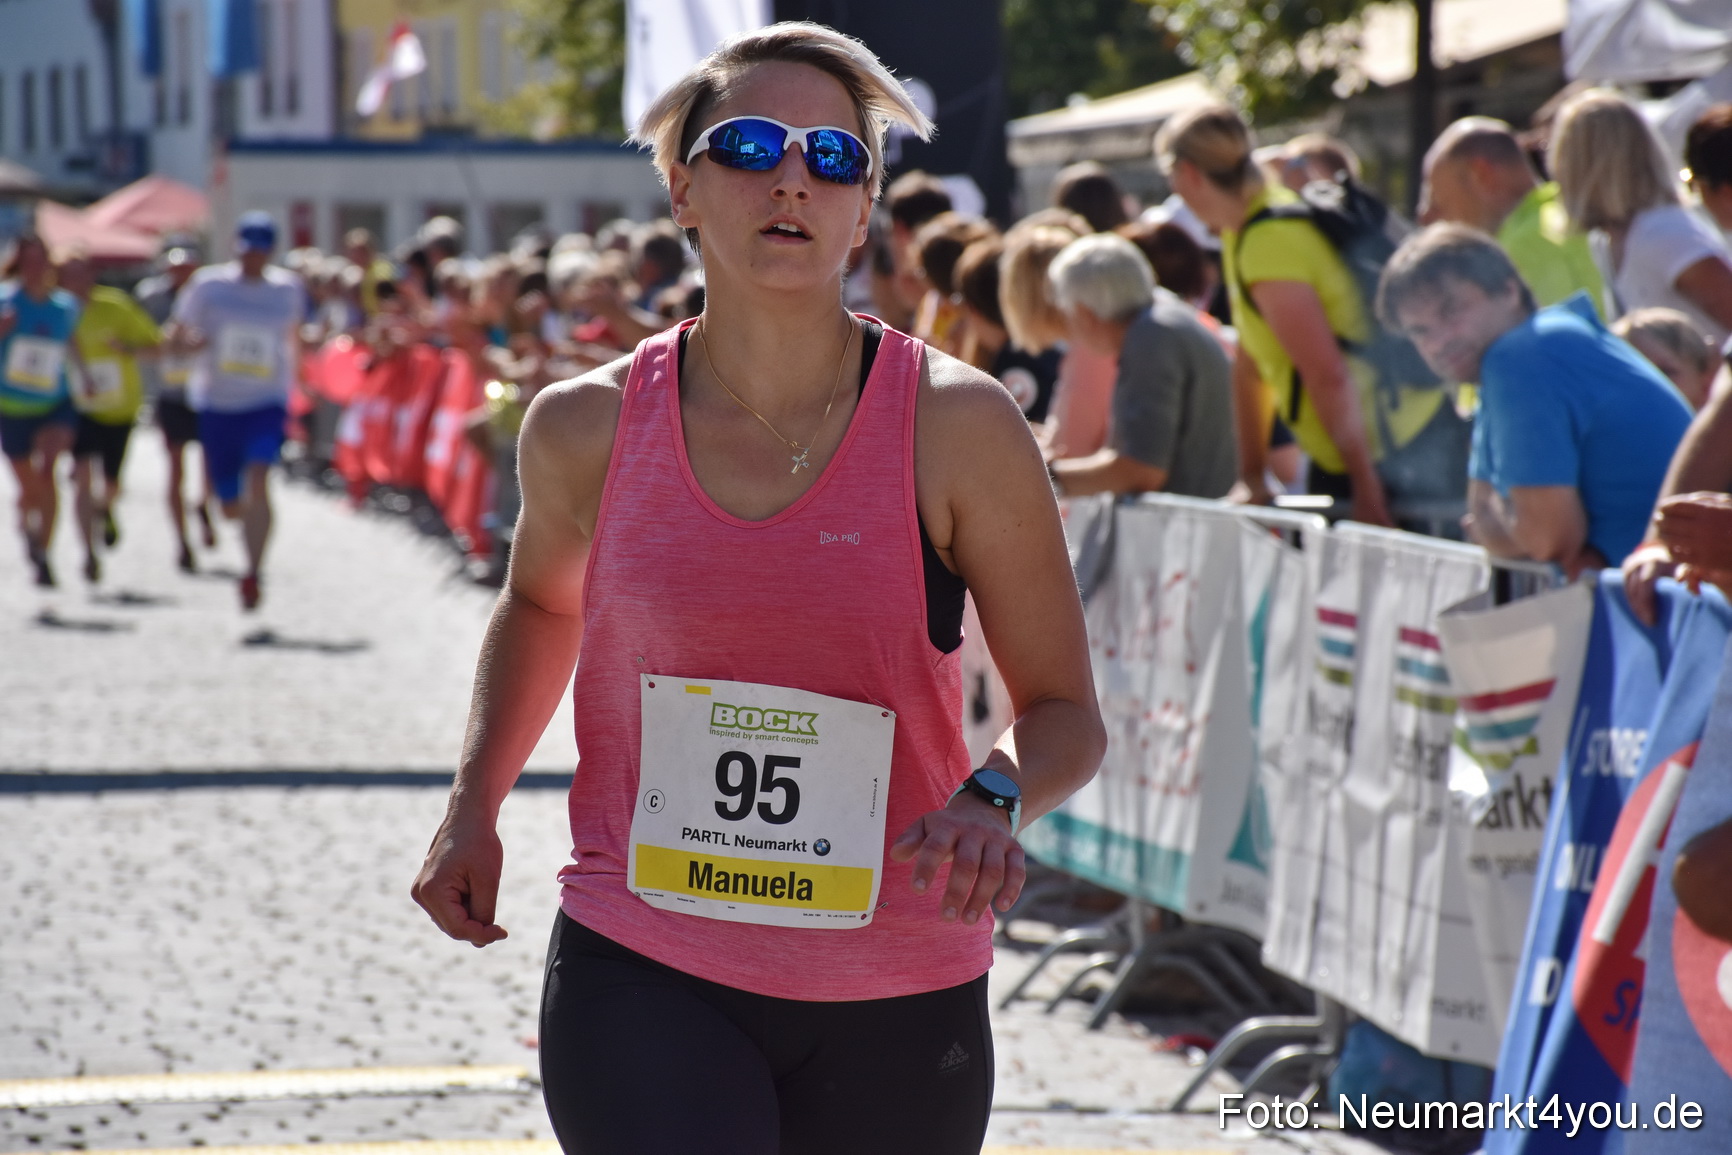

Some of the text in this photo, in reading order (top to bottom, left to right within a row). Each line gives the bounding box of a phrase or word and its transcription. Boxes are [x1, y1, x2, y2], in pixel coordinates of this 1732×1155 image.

[820, 531, 860, 545] USA PRO
[710, 702, 819, 736] BOCK
[709, 727, 819, 746] inspired by smart concepts
[714, 750, 801, 825] 95
[681, 827, 807, 853] PARTL Neumarkt
[688, 860, 813, 902] Manuela
